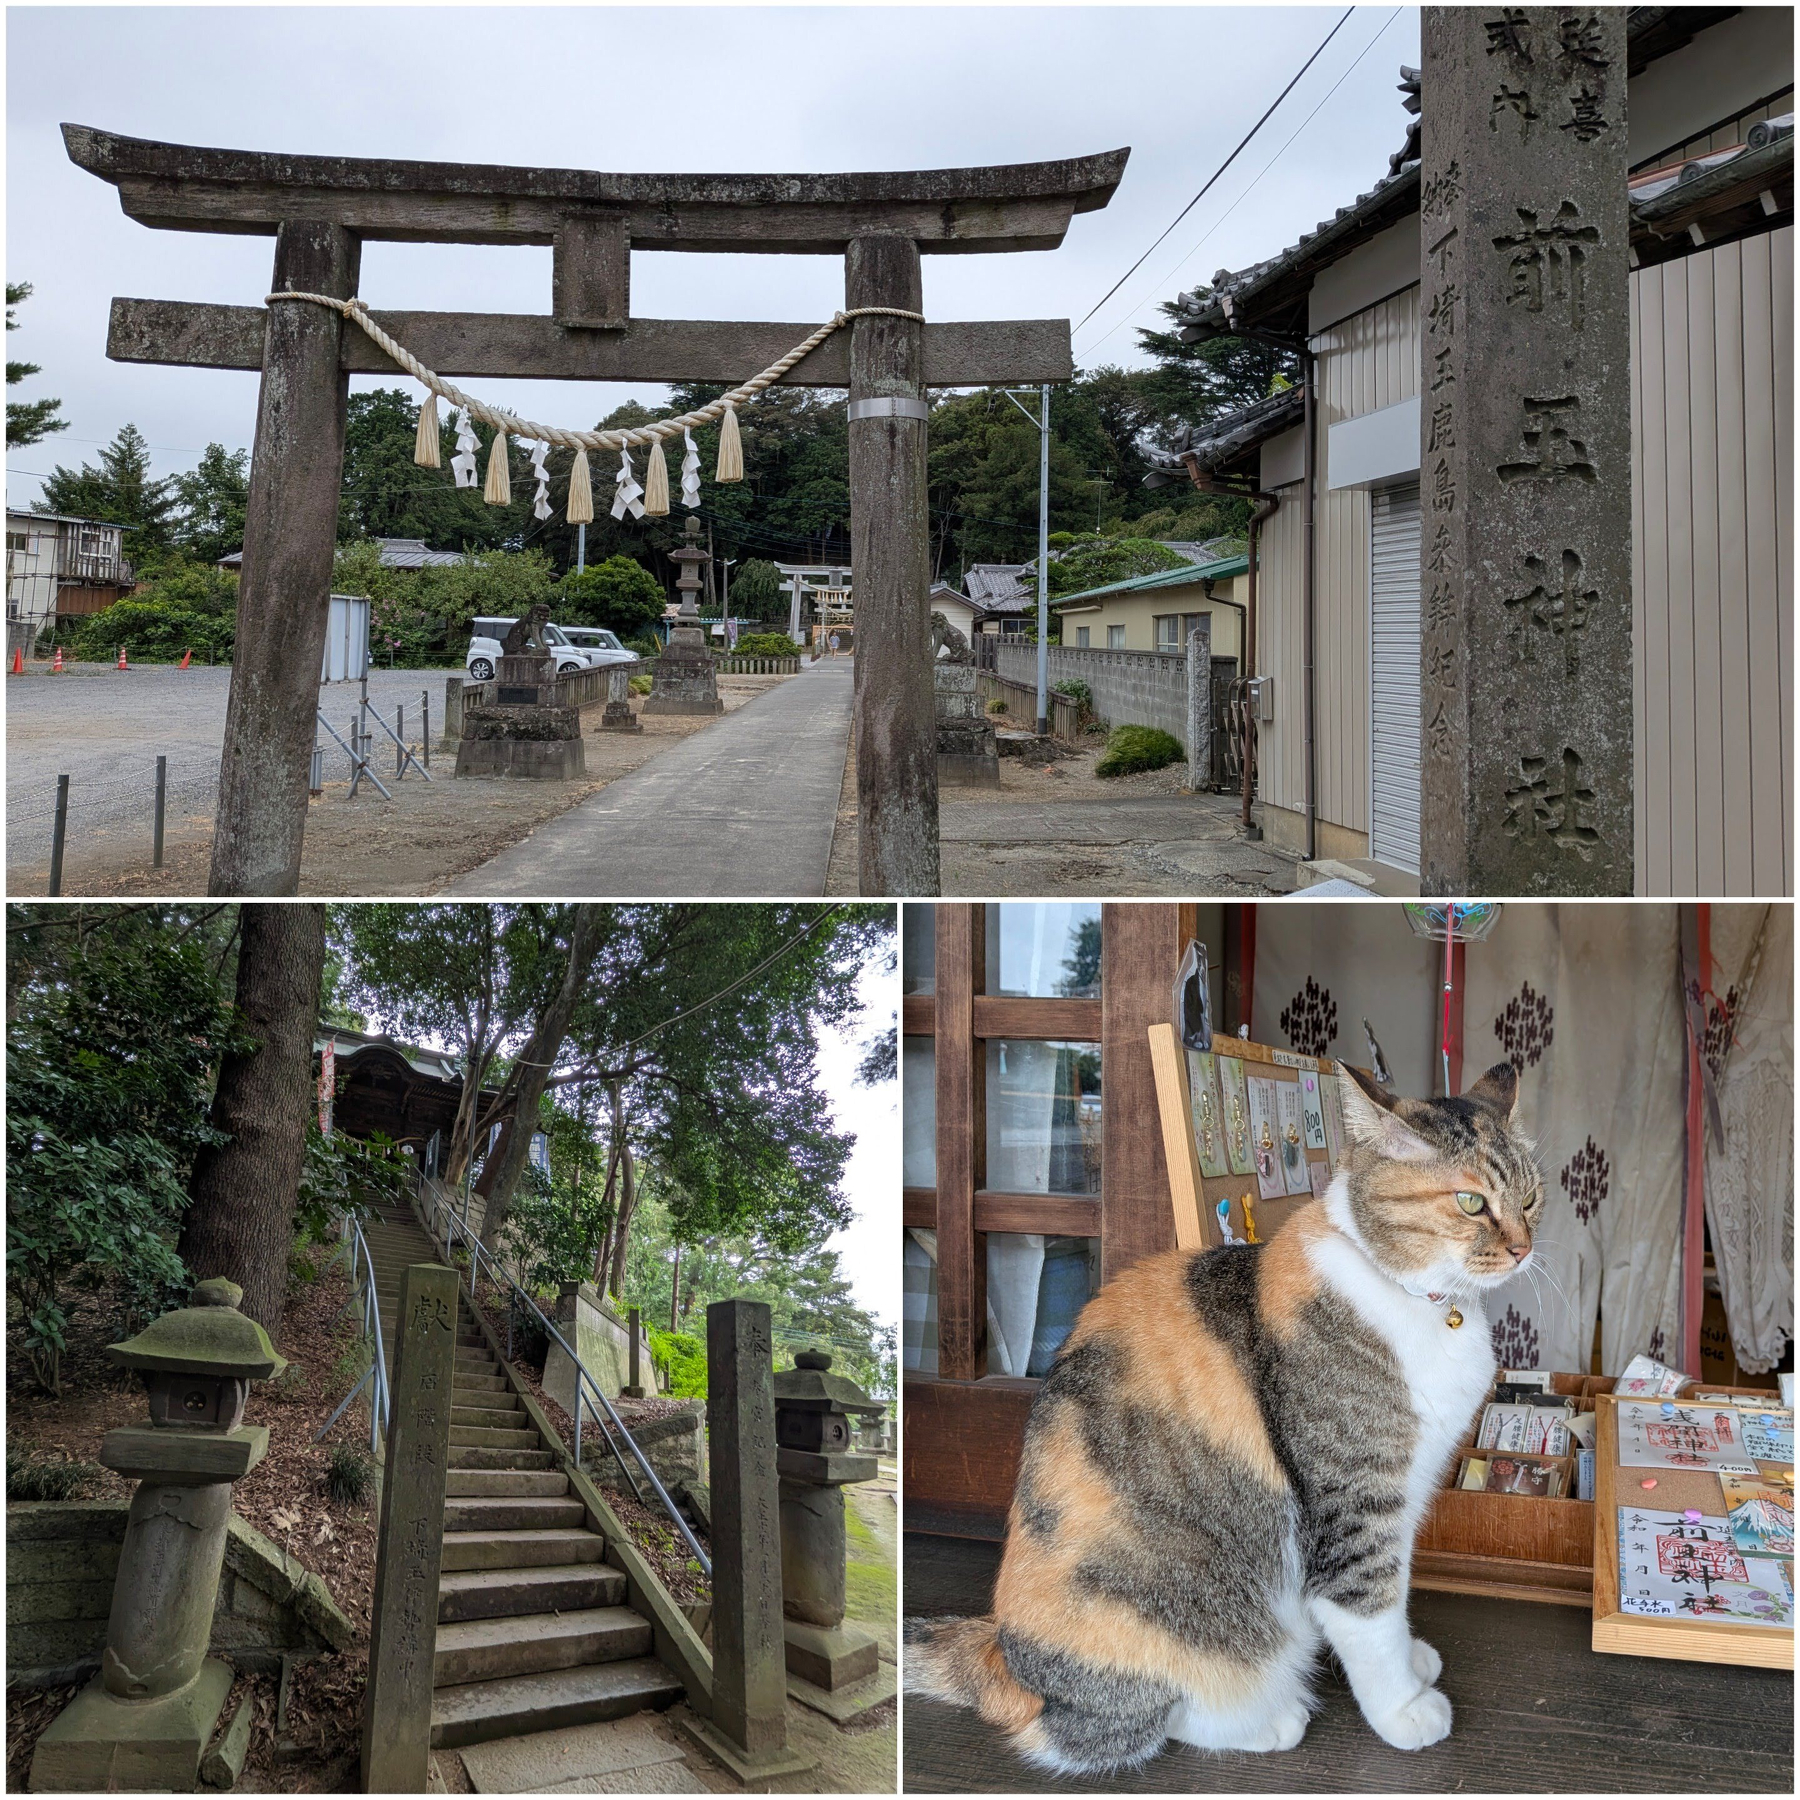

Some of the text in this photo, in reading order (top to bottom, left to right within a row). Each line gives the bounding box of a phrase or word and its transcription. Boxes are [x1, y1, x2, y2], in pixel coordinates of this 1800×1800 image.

[1484, 9, 1539, 145] 式内
[1492, 201, 1601, 853] 前玉神社
[1304, 1110, 1321, 1133] 800
[1313, 1128, 1324, 1144] 円
[746, 1326, 770, 1358] 奉
[1719, 1464, 1753, 1472] 400円
[1638, 1606, 1671, 1614] 500円
